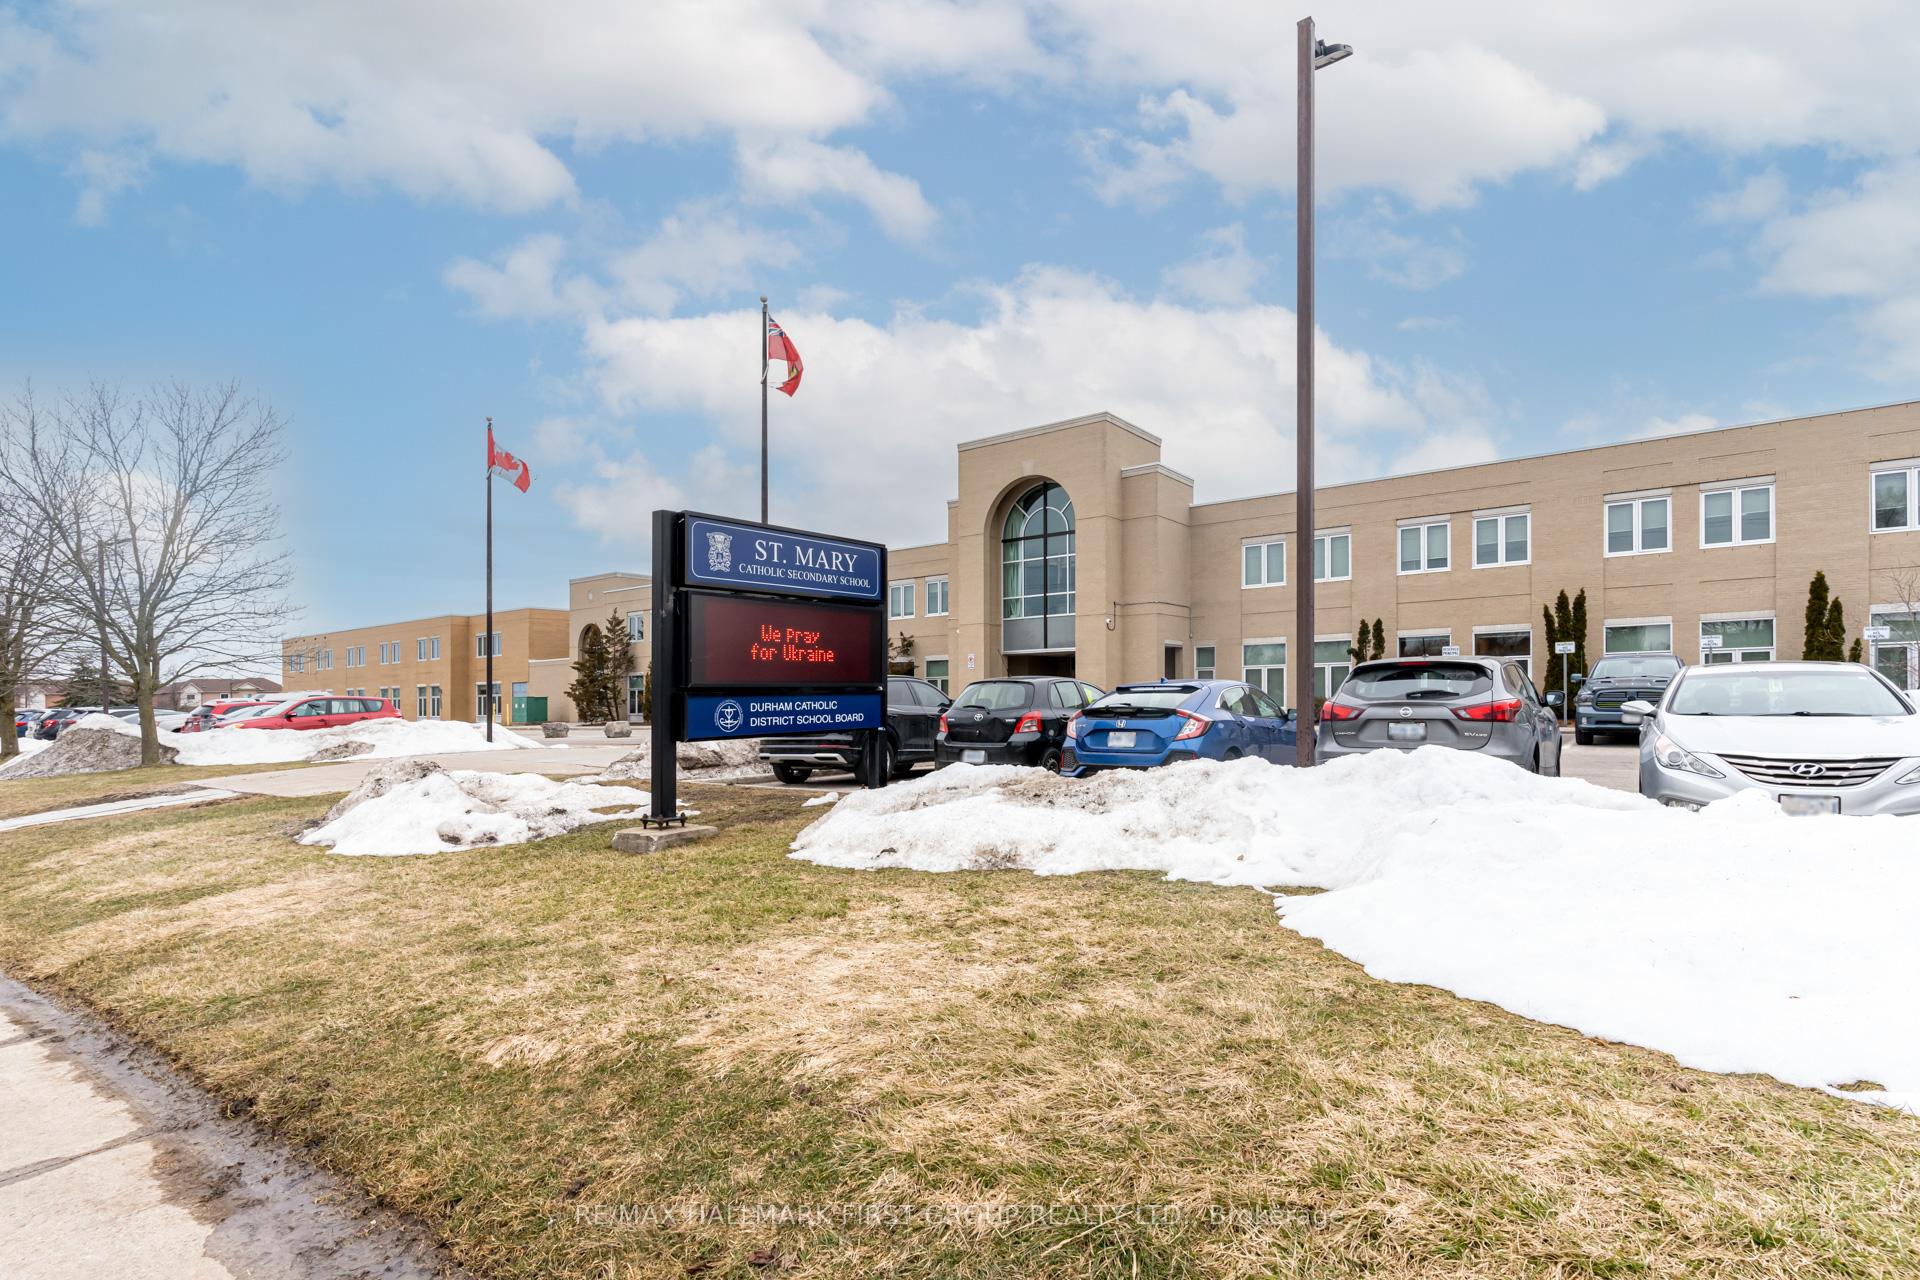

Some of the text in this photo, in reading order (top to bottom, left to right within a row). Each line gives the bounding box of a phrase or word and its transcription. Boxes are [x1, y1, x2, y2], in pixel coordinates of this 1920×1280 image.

[755, 539, 859, 573] ST. MARY
[738, 562, 871, 588] CATHOLIC SECONDARY SCHOOL
[761, 624, 820, 644] We Pray
[751, 642, 835, 662] for Ukraine
[750, 700, 838, 712] DURHAM CATHOLIC
[750, 712, 865, 727] DISTRICT SCHOOL BOARD
